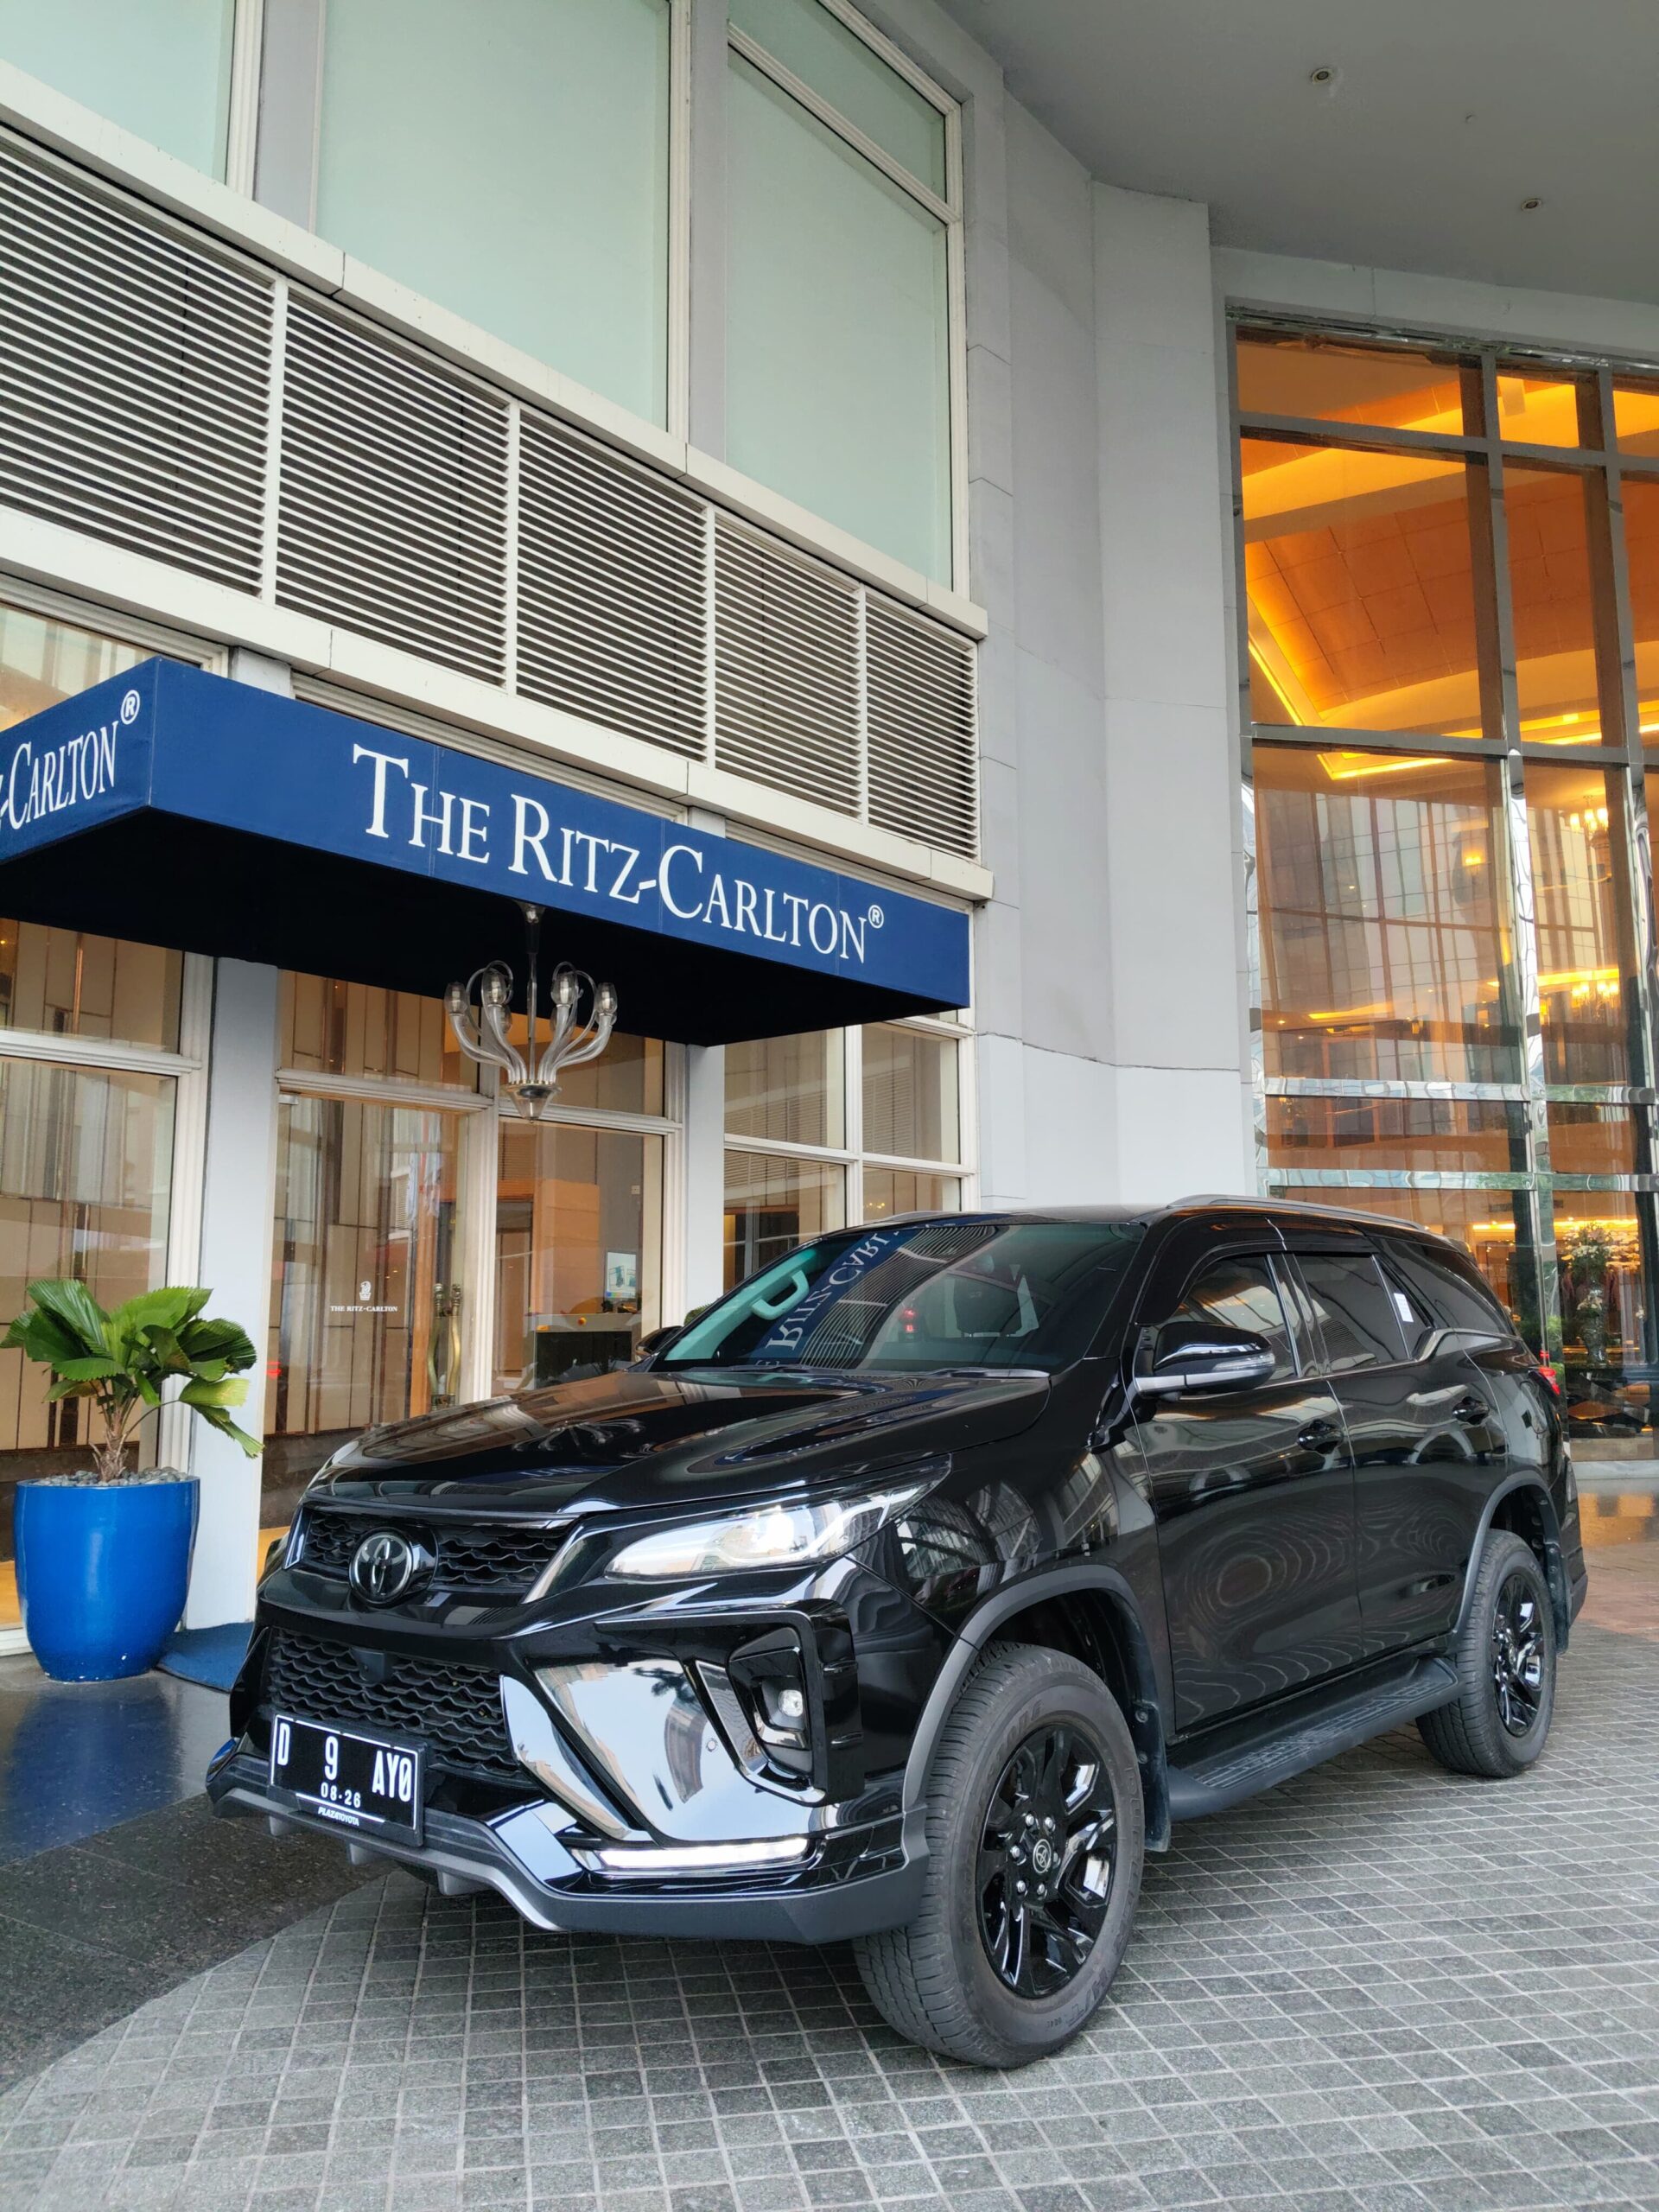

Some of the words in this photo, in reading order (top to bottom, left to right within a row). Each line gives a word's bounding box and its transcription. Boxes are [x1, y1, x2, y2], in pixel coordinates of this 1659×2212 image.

[353, 743, 491, 864] THE
[276, 1722, 290, 1766] D
[324, 1736, 339, 1781] 9
